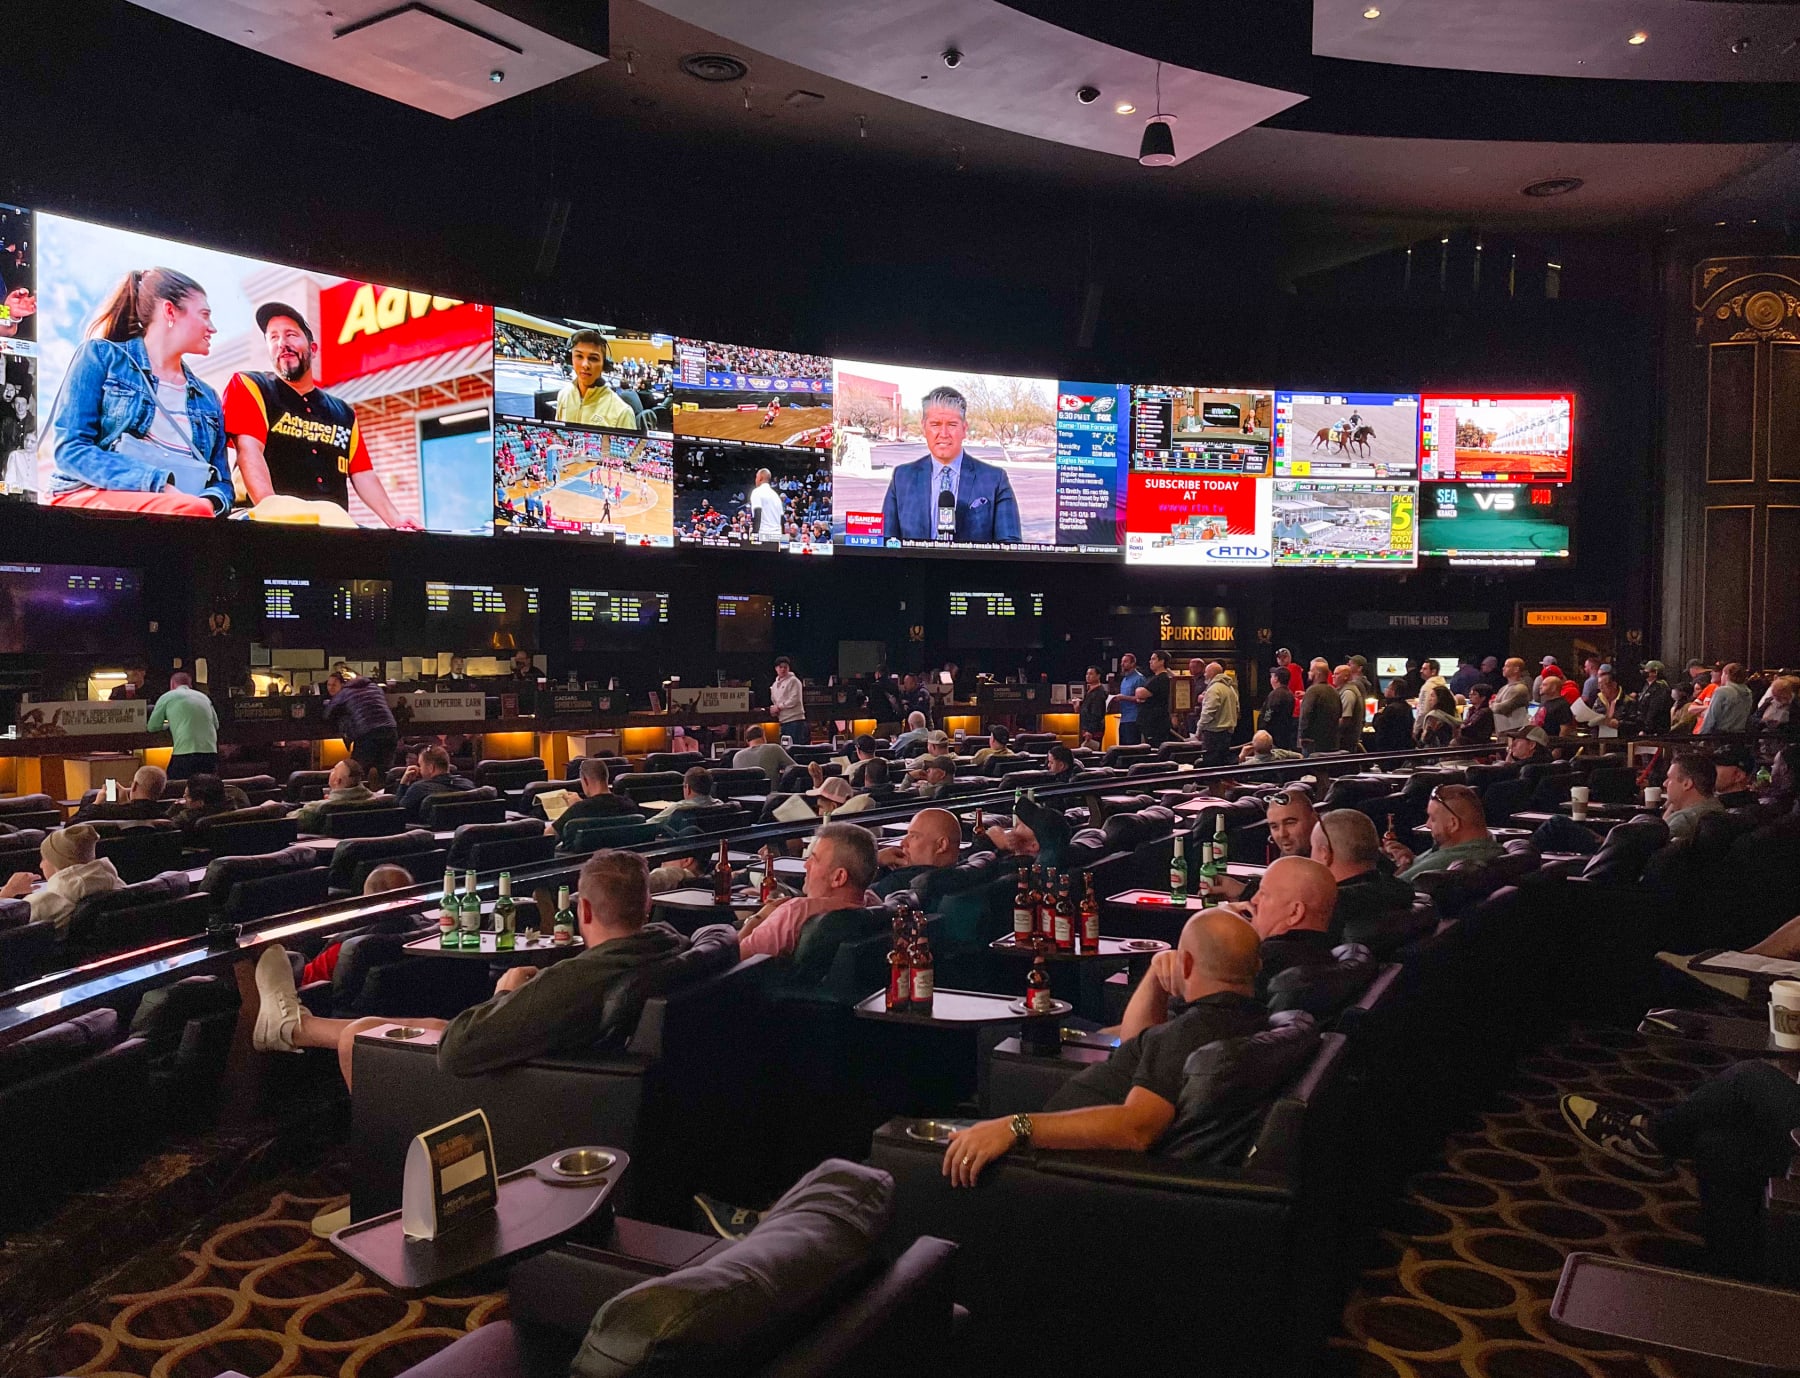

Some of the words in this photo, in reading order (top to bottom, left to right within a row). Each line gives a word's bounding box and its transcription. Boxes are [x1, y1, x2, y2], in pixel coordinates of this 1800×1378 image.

[474, 304, 483, 312] 12
[1058, 412, 1073, 420] 6:30
[1097, 413, 1112, 422] FOX
[279, 411, 332, 434] Advance
[271, 421, 302, 438] Auto
[303, 429, 332, 444] Parts
[1145, 479, 1201, 490] SUBSCRIBE
[1203, 481, 1239, 491] TODAY
[1183, 491, 1198, 501] AT
[1392, 495, 1413, 503] PICK
[1437, 489, 1457, 504] SEA
[1473, 493, 1515, 511] VS
[1392, 503, 1413, 531] 5
[1391, 535, 1413, 543] POOL
[1219, 547, 1258, 557] RTN
[1389, 615, 1420, 625] BETTING
[1422, 615, 1449, 626] KIOSKS
[1160, 626, 1235, 641] SPORTSBOOK
[415, 698, 431, 708] EARN
[465, 698, 482, 707] EARN
